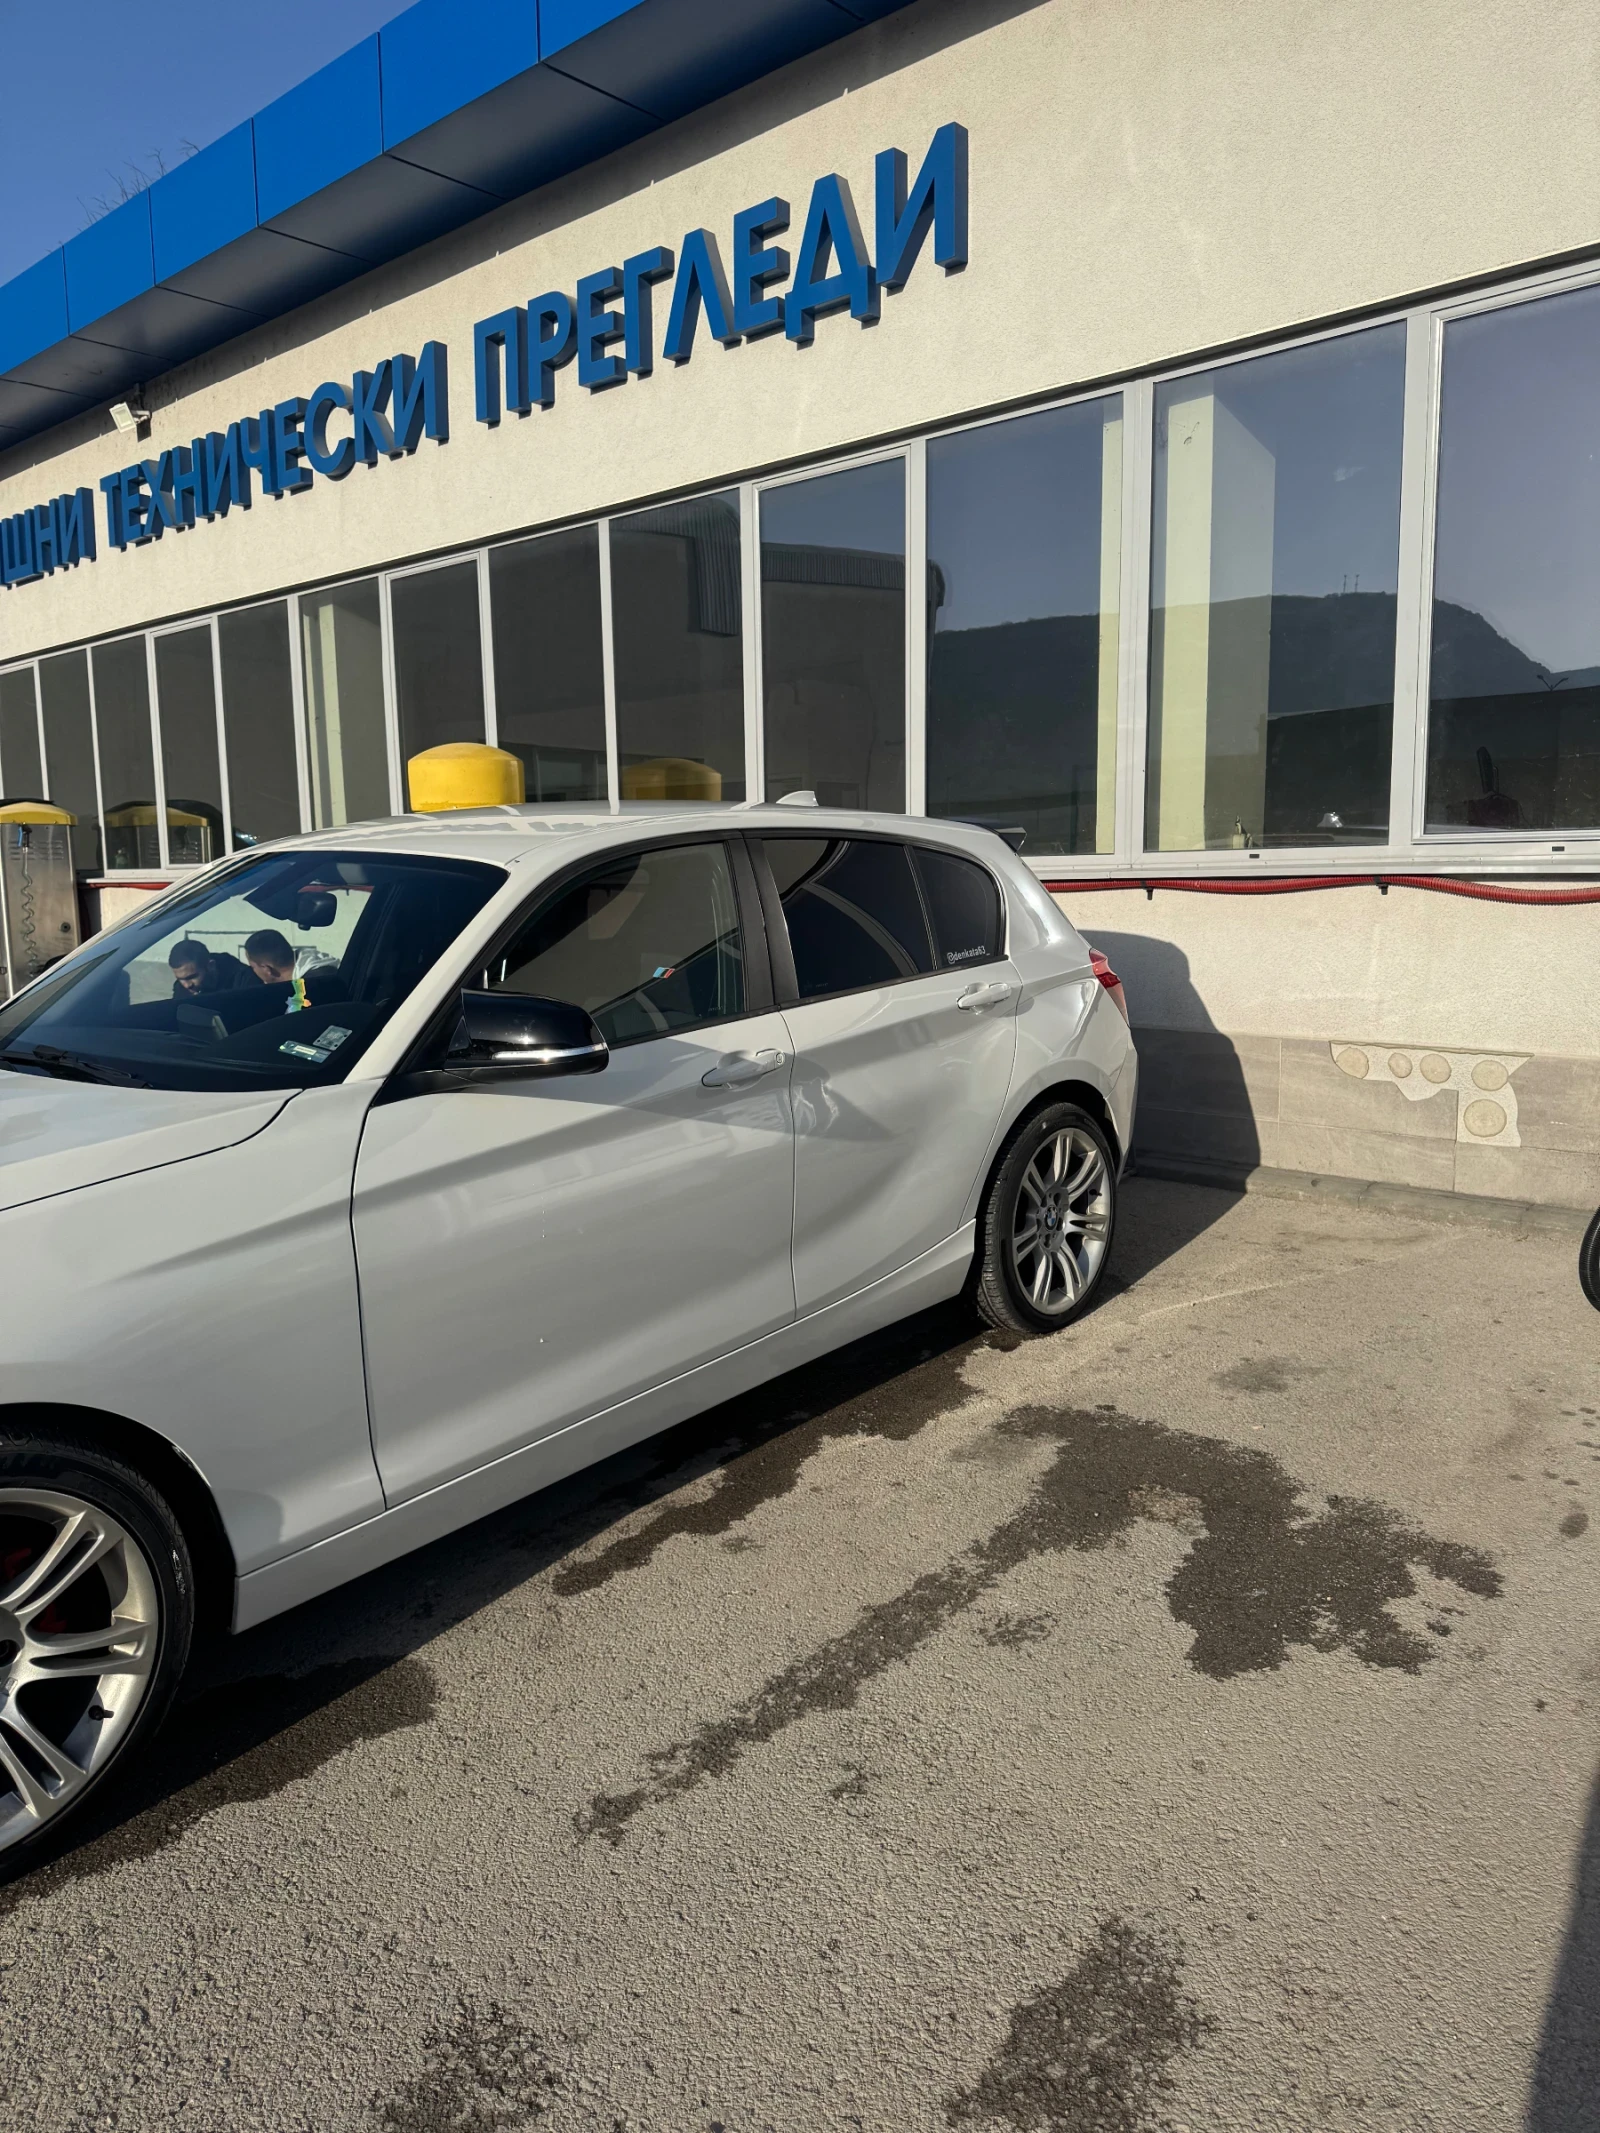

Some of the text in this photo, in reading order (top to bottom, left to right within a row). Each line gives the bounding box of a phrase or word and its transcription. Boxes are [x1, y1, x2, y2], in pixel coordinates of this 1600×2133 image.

[0, 121, 968, 586] ШНИ ТЕХНИЧЕСКИ ПРЕГЛЕДИ
